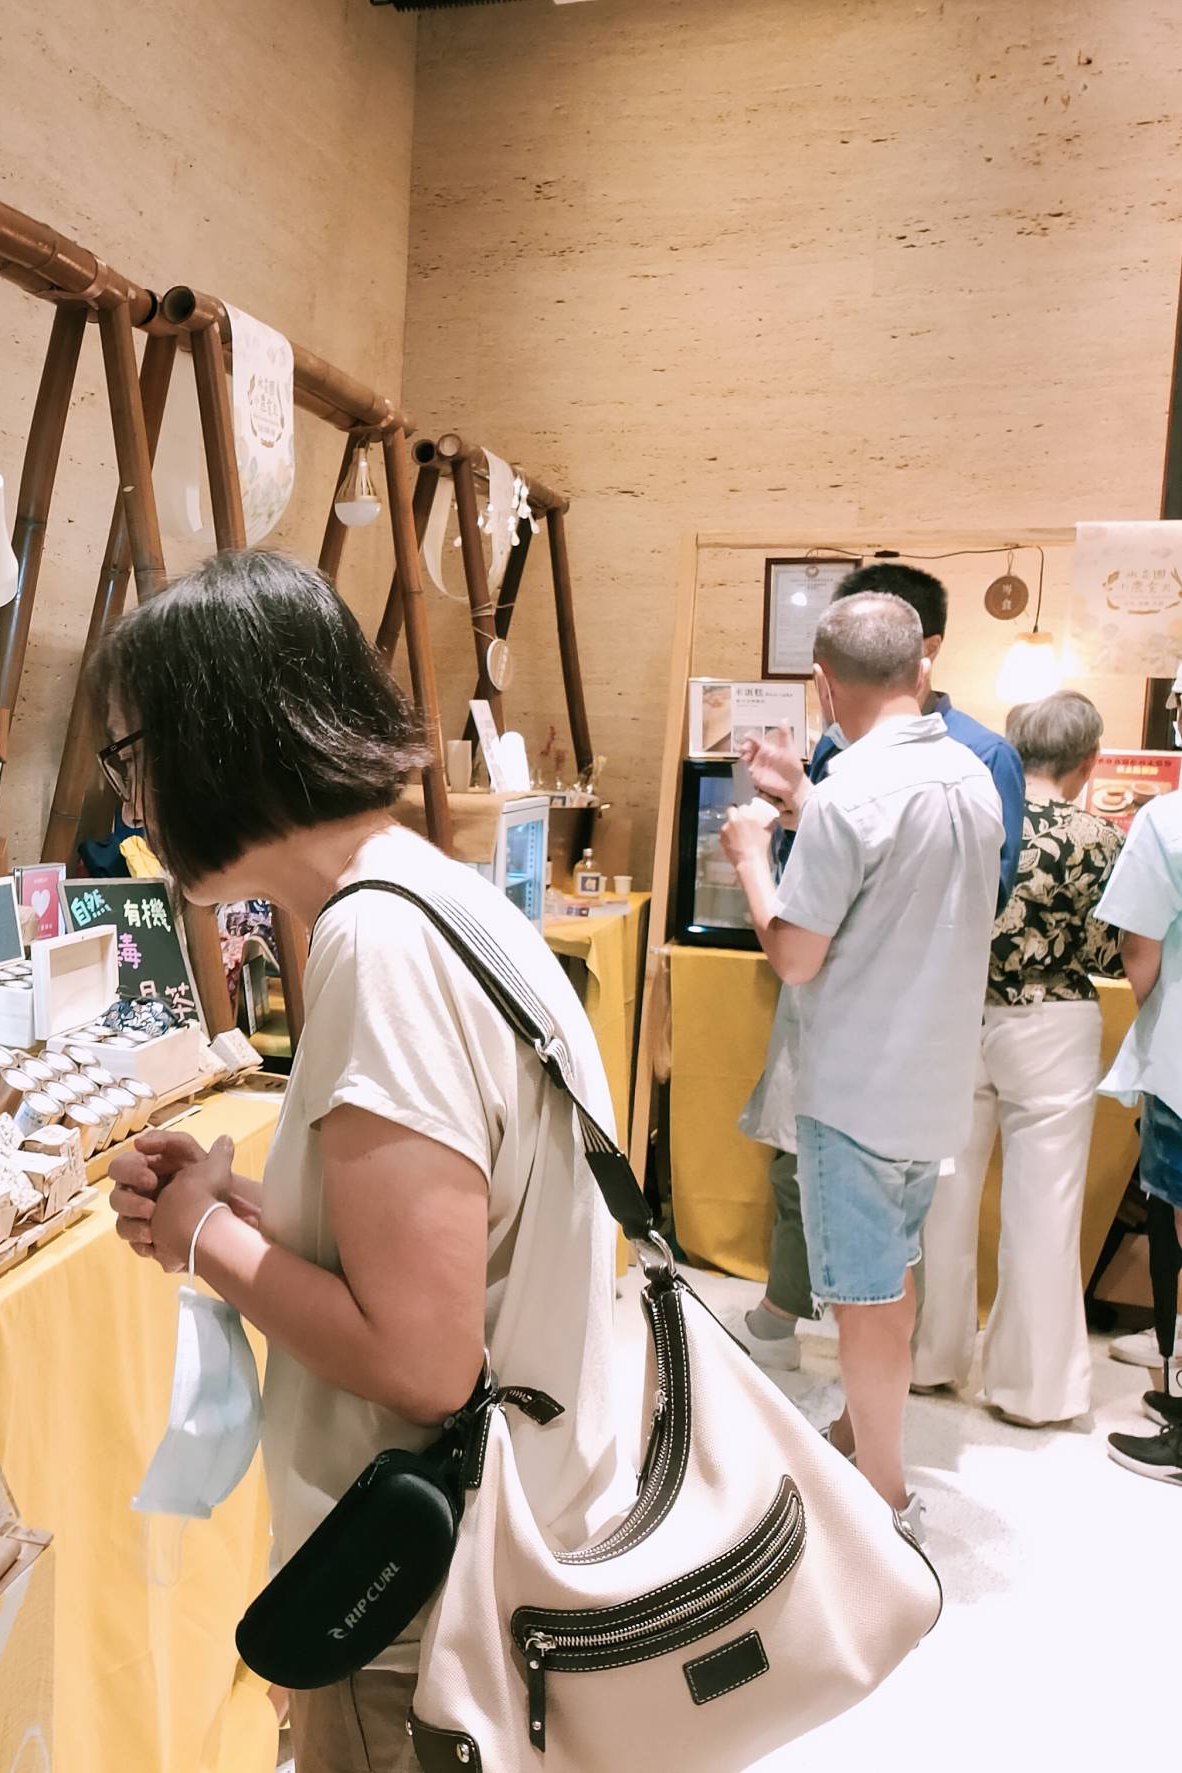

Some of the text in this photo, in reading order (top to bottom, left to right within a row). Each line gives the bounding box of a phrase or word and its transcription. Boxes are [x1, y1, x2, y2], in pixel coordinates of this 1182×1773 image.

[70, 889, 171, 933] 自然 有機
[117, 932, 143, 970] 毒
[344, 1561, 401, 1629] RIP CURL
